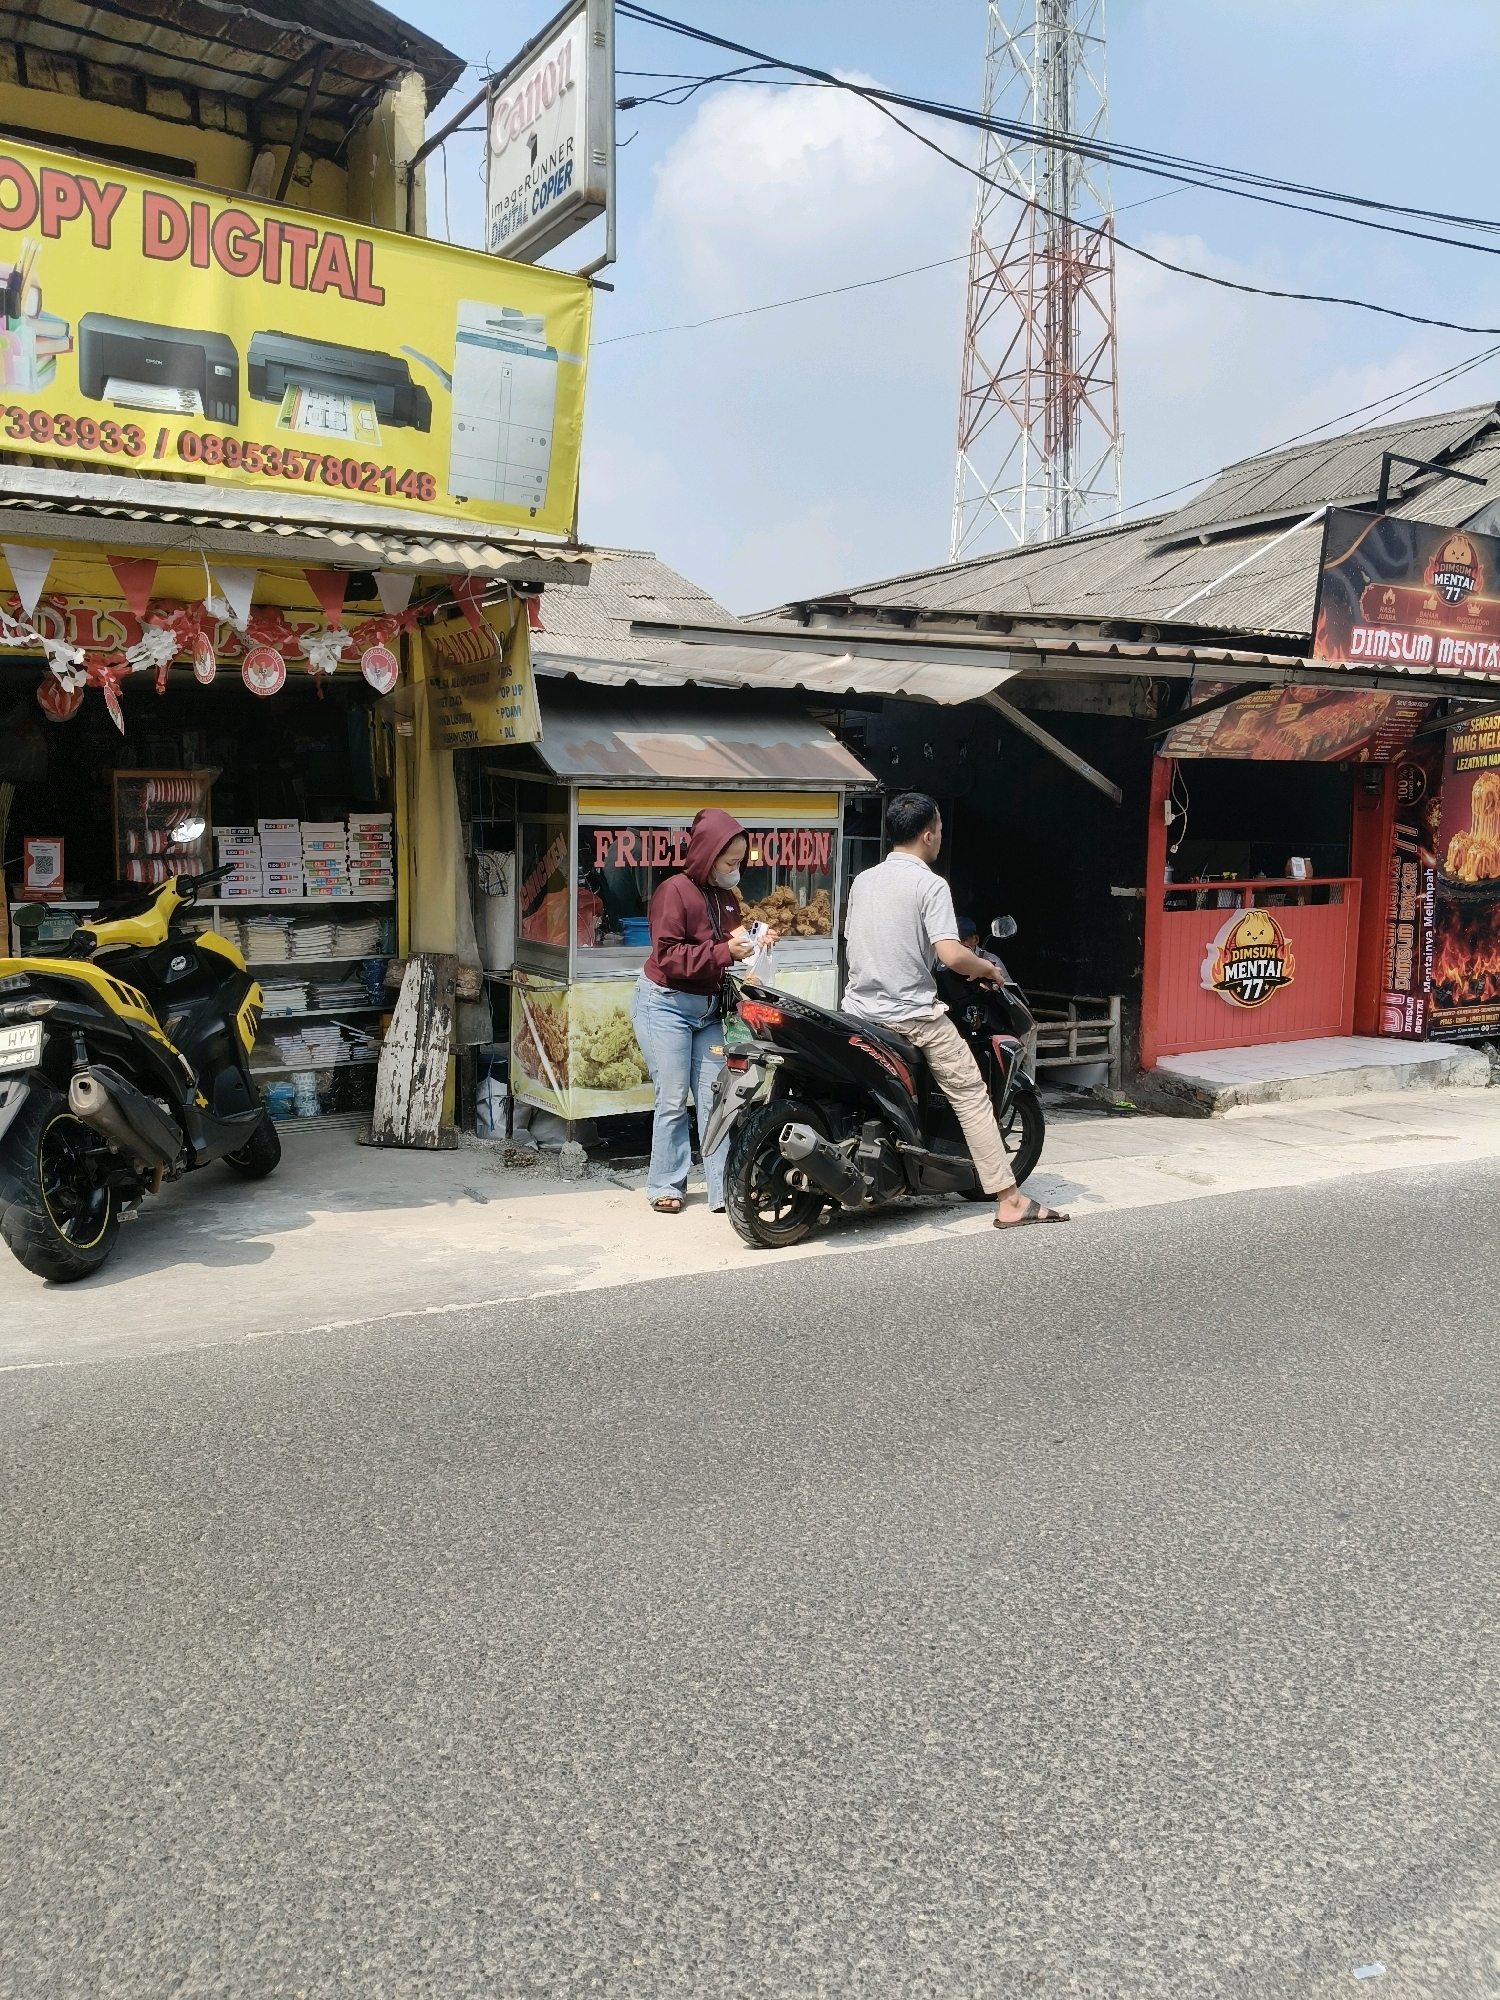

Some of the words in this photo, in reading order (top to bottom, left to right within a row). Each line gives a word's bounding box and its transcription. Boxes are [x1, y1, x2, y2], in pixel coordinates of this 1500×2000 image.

[490, 37, 574, 156] Canon
[491, 136, 574, 219] imageRUNNER
[491, 197, 528, 249] DIGITAL
[531, 159, 573, 216] COPIER
[143, 190, 385, 306] DIGITAL
[0, 404, 146, 457] 393933
[177, 430, 436, 501] 0895357802148
[1434, 573, 1475, 590] MENTAI
[1440, 564, 1472, 576] DIMSUM
[1380, 606, 1396, 614] RASA
[1445, 586, 1460, 601] 77
[432, 623, 500, 668] FAMILY
[1350, 628, 1433, 661] DIMSUM
[1437, 636, 1500, 667] MENTA
[512, 684, 524, 696] UP
[500, 705, 522, 719] PDAM
[505, 726, 515, 738] DLL
[1452, 734, 1477, 753] YANG
[1457, 755, 1487, 770] LEZATNYA
[1398, 769, 1408, 800] 100%
[593, 830, 692, 868] FRIED
[518, 831, 568, 912] CHICKEN
[1399, 862, 1418, 921] BAKAR
[1423, 868, 1434, 927] Melimpah
[1232, 947, 1276, 960] DIMSUM
[1395, 923, 1415, 991] DIMSUM
[1423, 930, 1433, 993] Mentainya
[1225, 960, 1283, 981] MENTAI
[1243, 979, 1264, 999] 77
[1405, 997, 1414, 1032] DIMSUM
[1415, 1000, 1424, 1034] MENTAI
